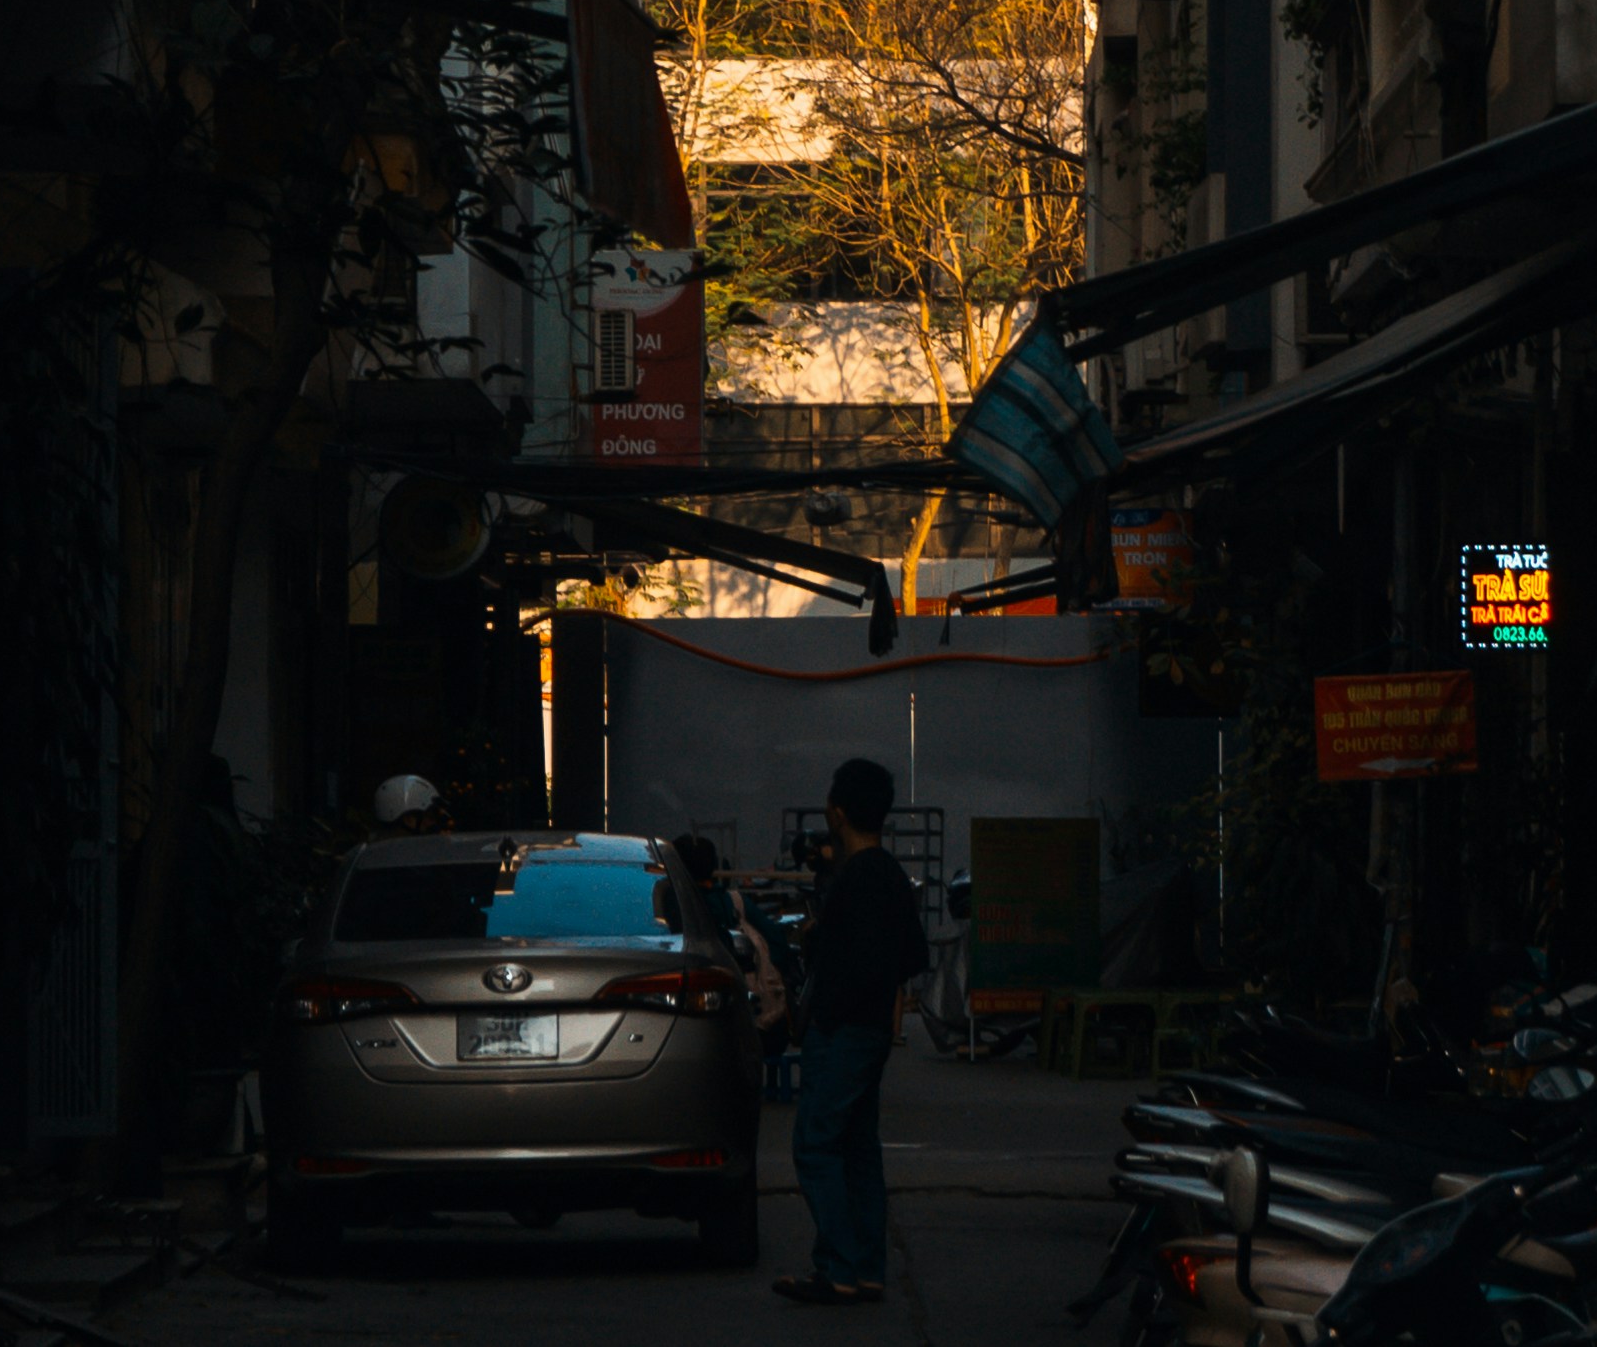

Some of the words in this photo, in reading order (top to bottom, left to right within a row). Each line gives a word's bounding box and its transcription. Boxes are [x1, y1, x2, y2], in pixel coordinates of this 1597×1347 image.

[602, 404, 684, 420] PHƯƠNG
[601, 435, 655, 456] ĐÔNG
[1496, 551, 1521, 568] TRÀ
[1473, 569, 1517, 601] TRÀ
[1519, 570, 1549, 601] SỮ
[1471, 604, 1496, 623] TRÀ
[1497, 604, 1526, 623] TRÁI
[1408, 731, 1459, 751] SANG
